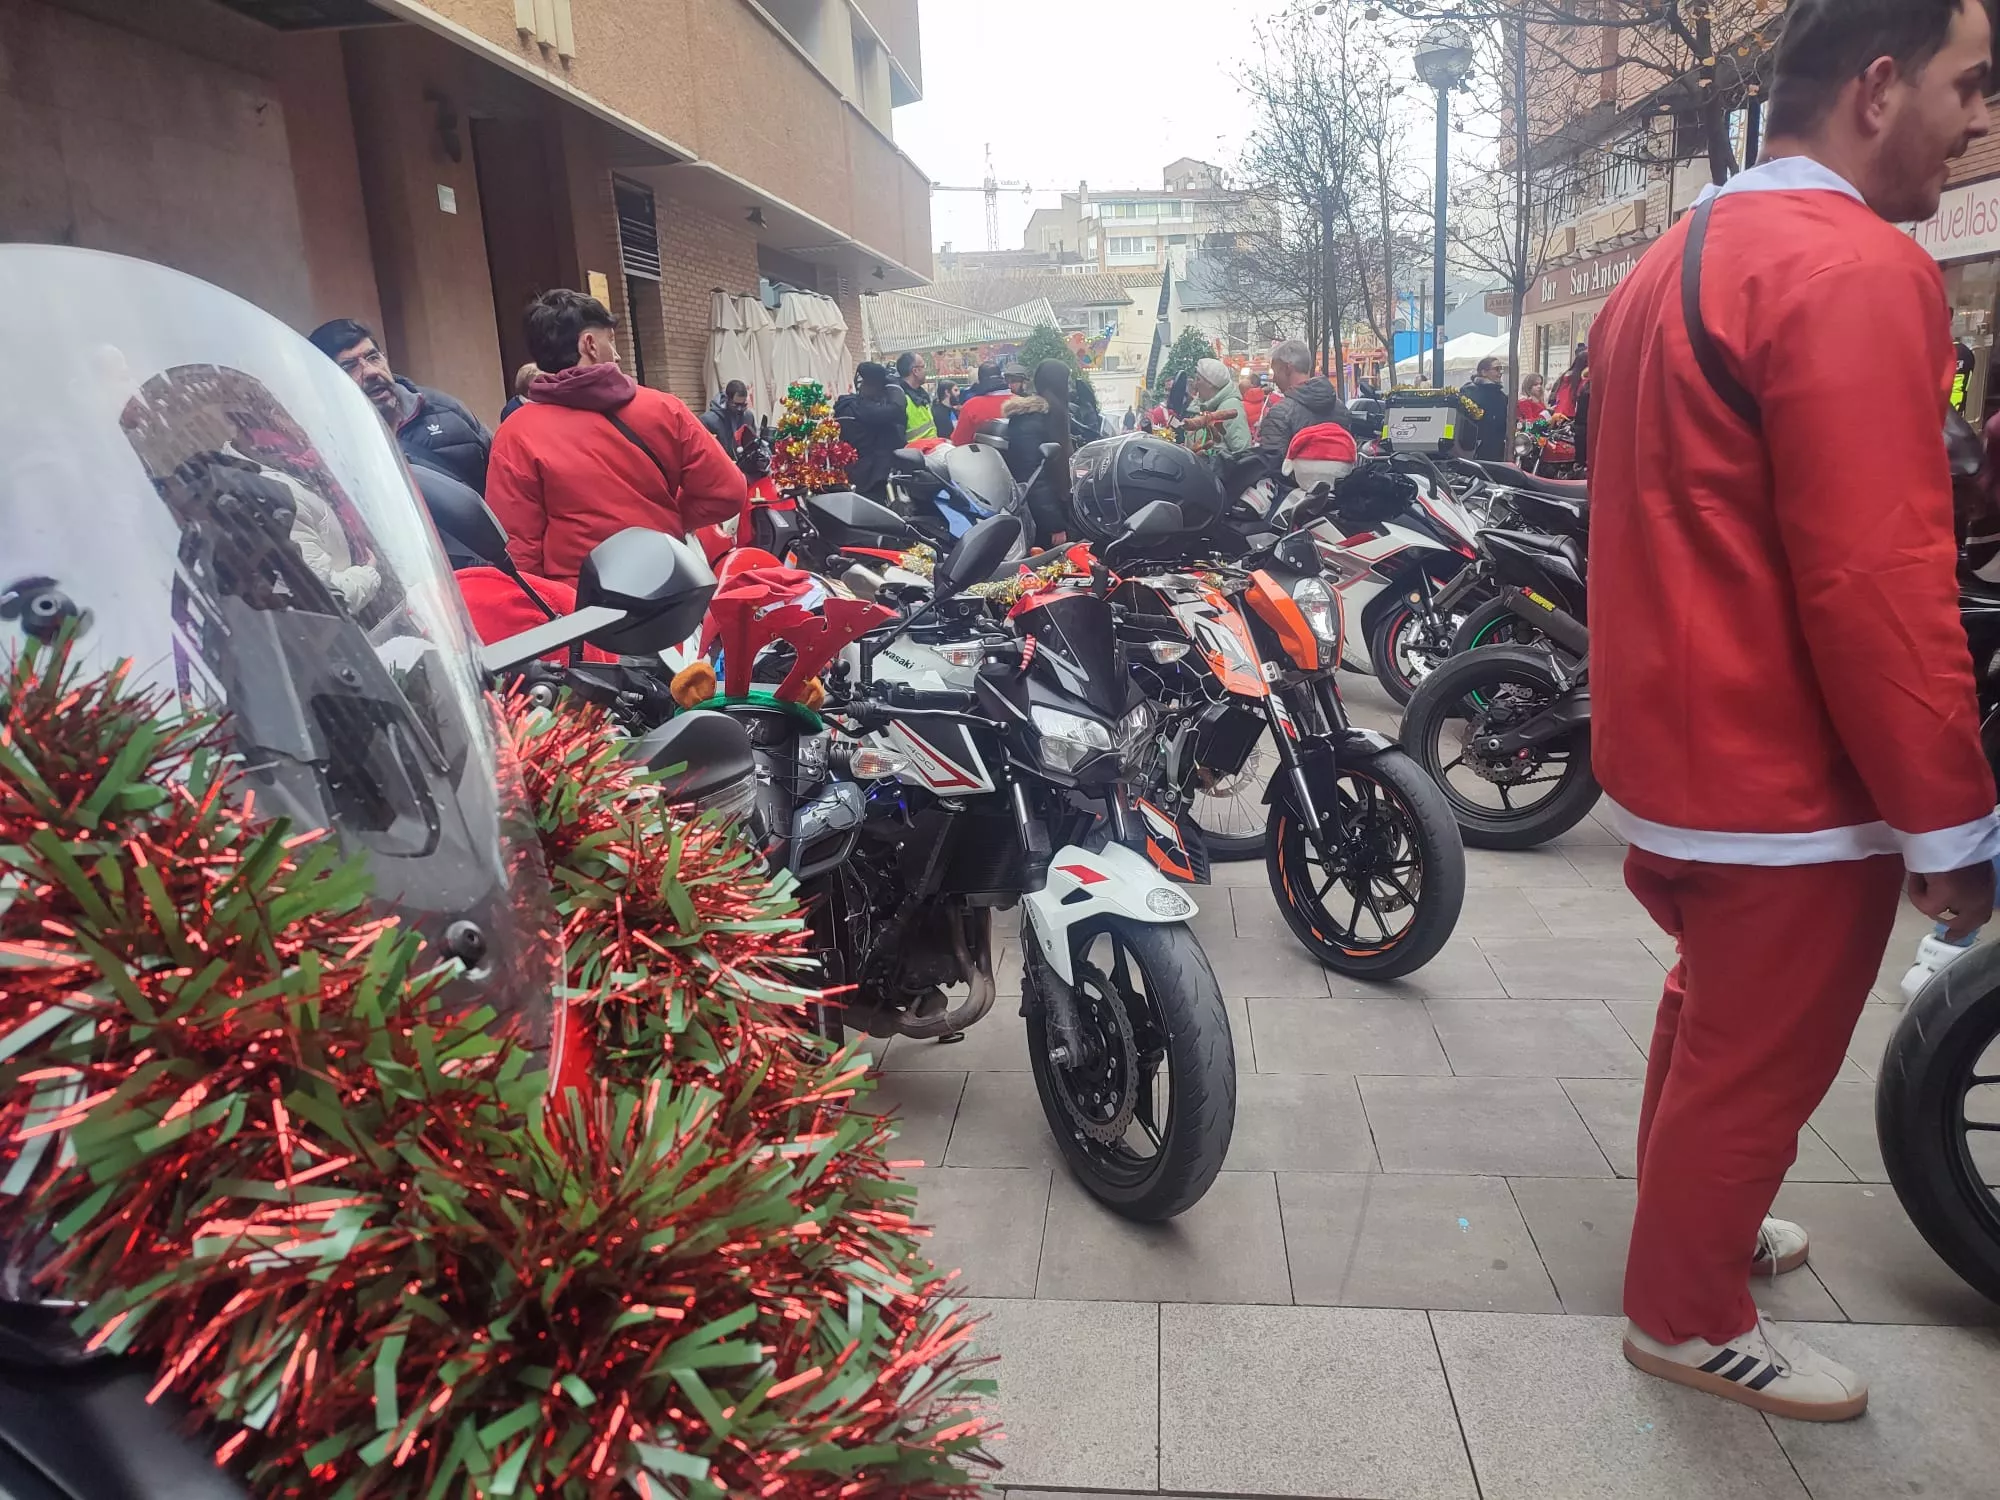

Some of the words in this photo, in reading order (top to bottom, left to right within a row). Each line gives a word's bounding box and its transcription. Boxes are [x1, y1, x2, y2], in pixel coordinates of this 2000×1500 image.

[1542, 276, 1557, 303] Bar
[1570, 267, 1589, 296] San
[1489, 298, 1513, 309] AMBA
[882, 649, 915, 669] wasaki
